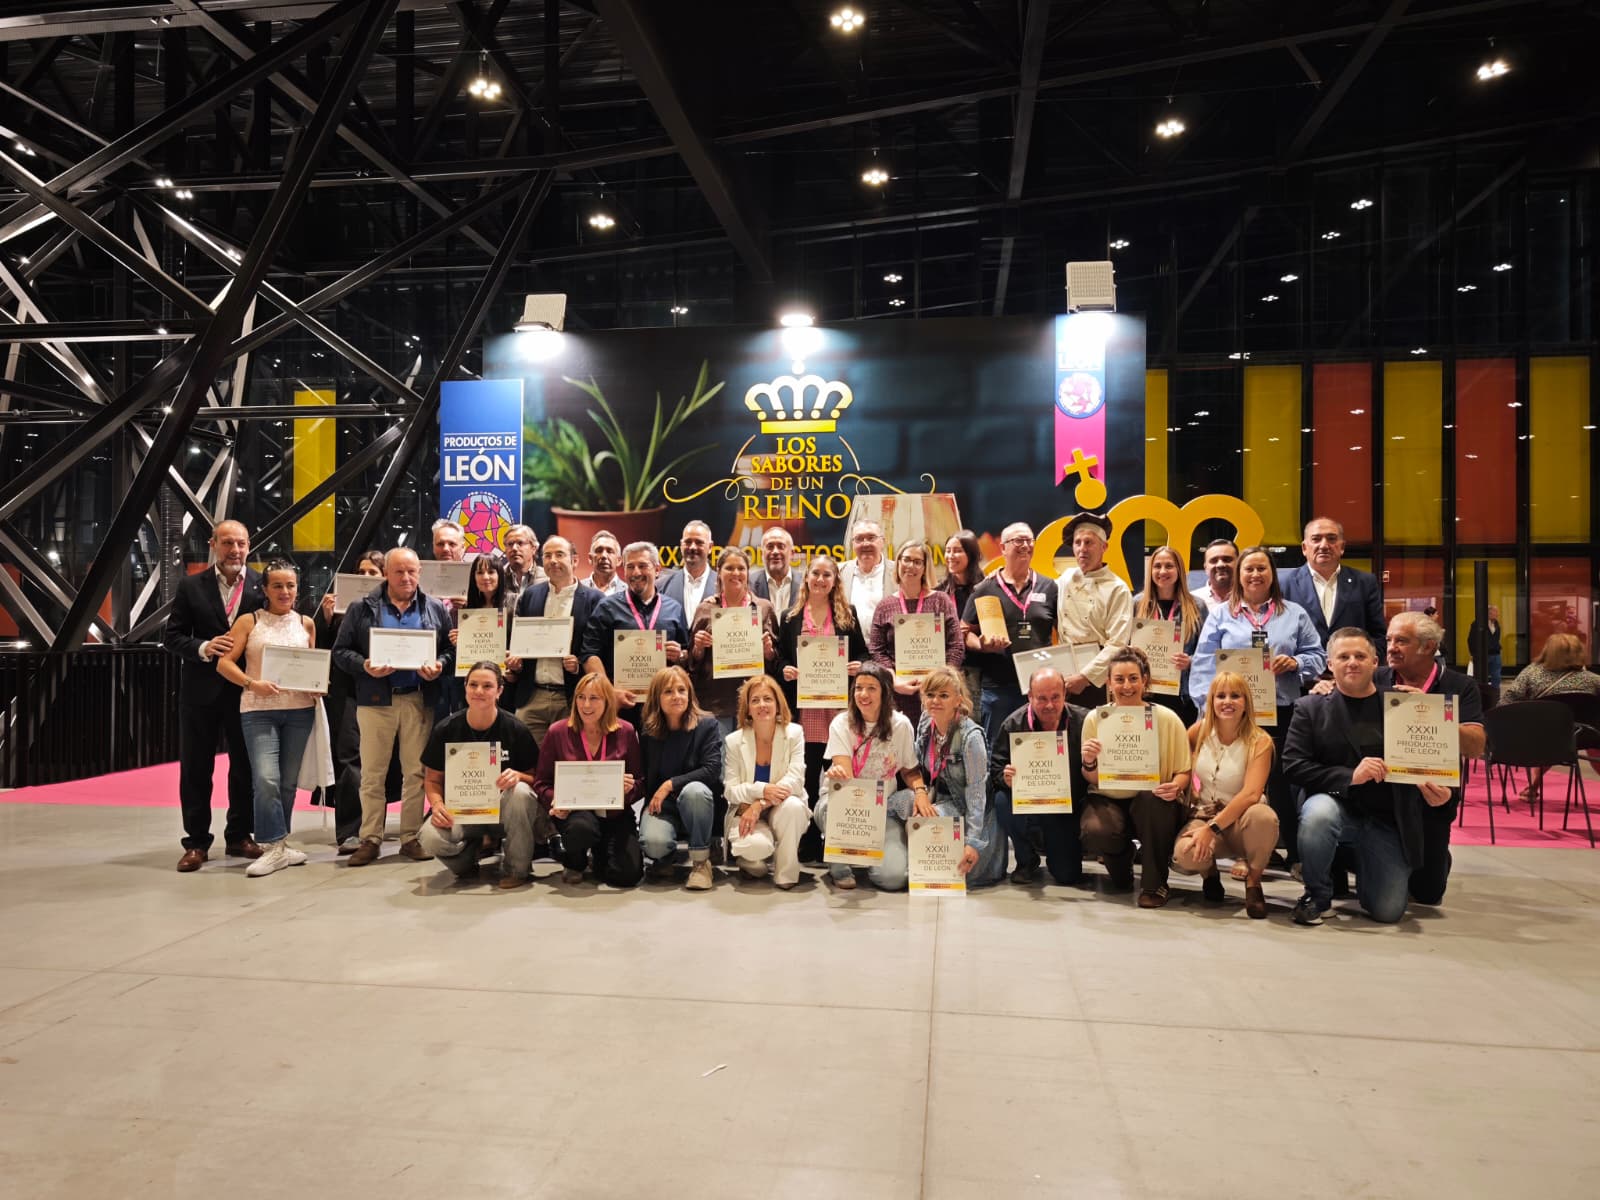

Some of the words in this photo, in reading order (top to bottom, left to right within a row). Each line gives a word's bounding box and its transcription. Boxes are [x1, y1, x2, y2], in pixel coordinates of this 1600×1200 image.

[444, 436, 502, 447] PRODUCTOS
[504, 435, 517, 446] DE
[776, 436, 817, 455] LOS
[444, 447, 515, 482] LEÓN
[751, 454, 843, 474] SABORES
[770, 477, 793, 491] DE
[797, 476, 824, 490] UN
[741, 493, 852, 520] REINO
[1406, 725, 1438, 735] XXXII
[1115, 734, 1141, 742] XXXII
[1397, 740, 1448, 749] PRODUCTOS
[1028, 760, 1053, 768] XXXII
[462, 770, 486, 778] XXXII
[844, 808, 871, 818] XXXII
[835, 823, 878, 831] PRODUCTOS
[925, 845, 950, 853] XXXII
